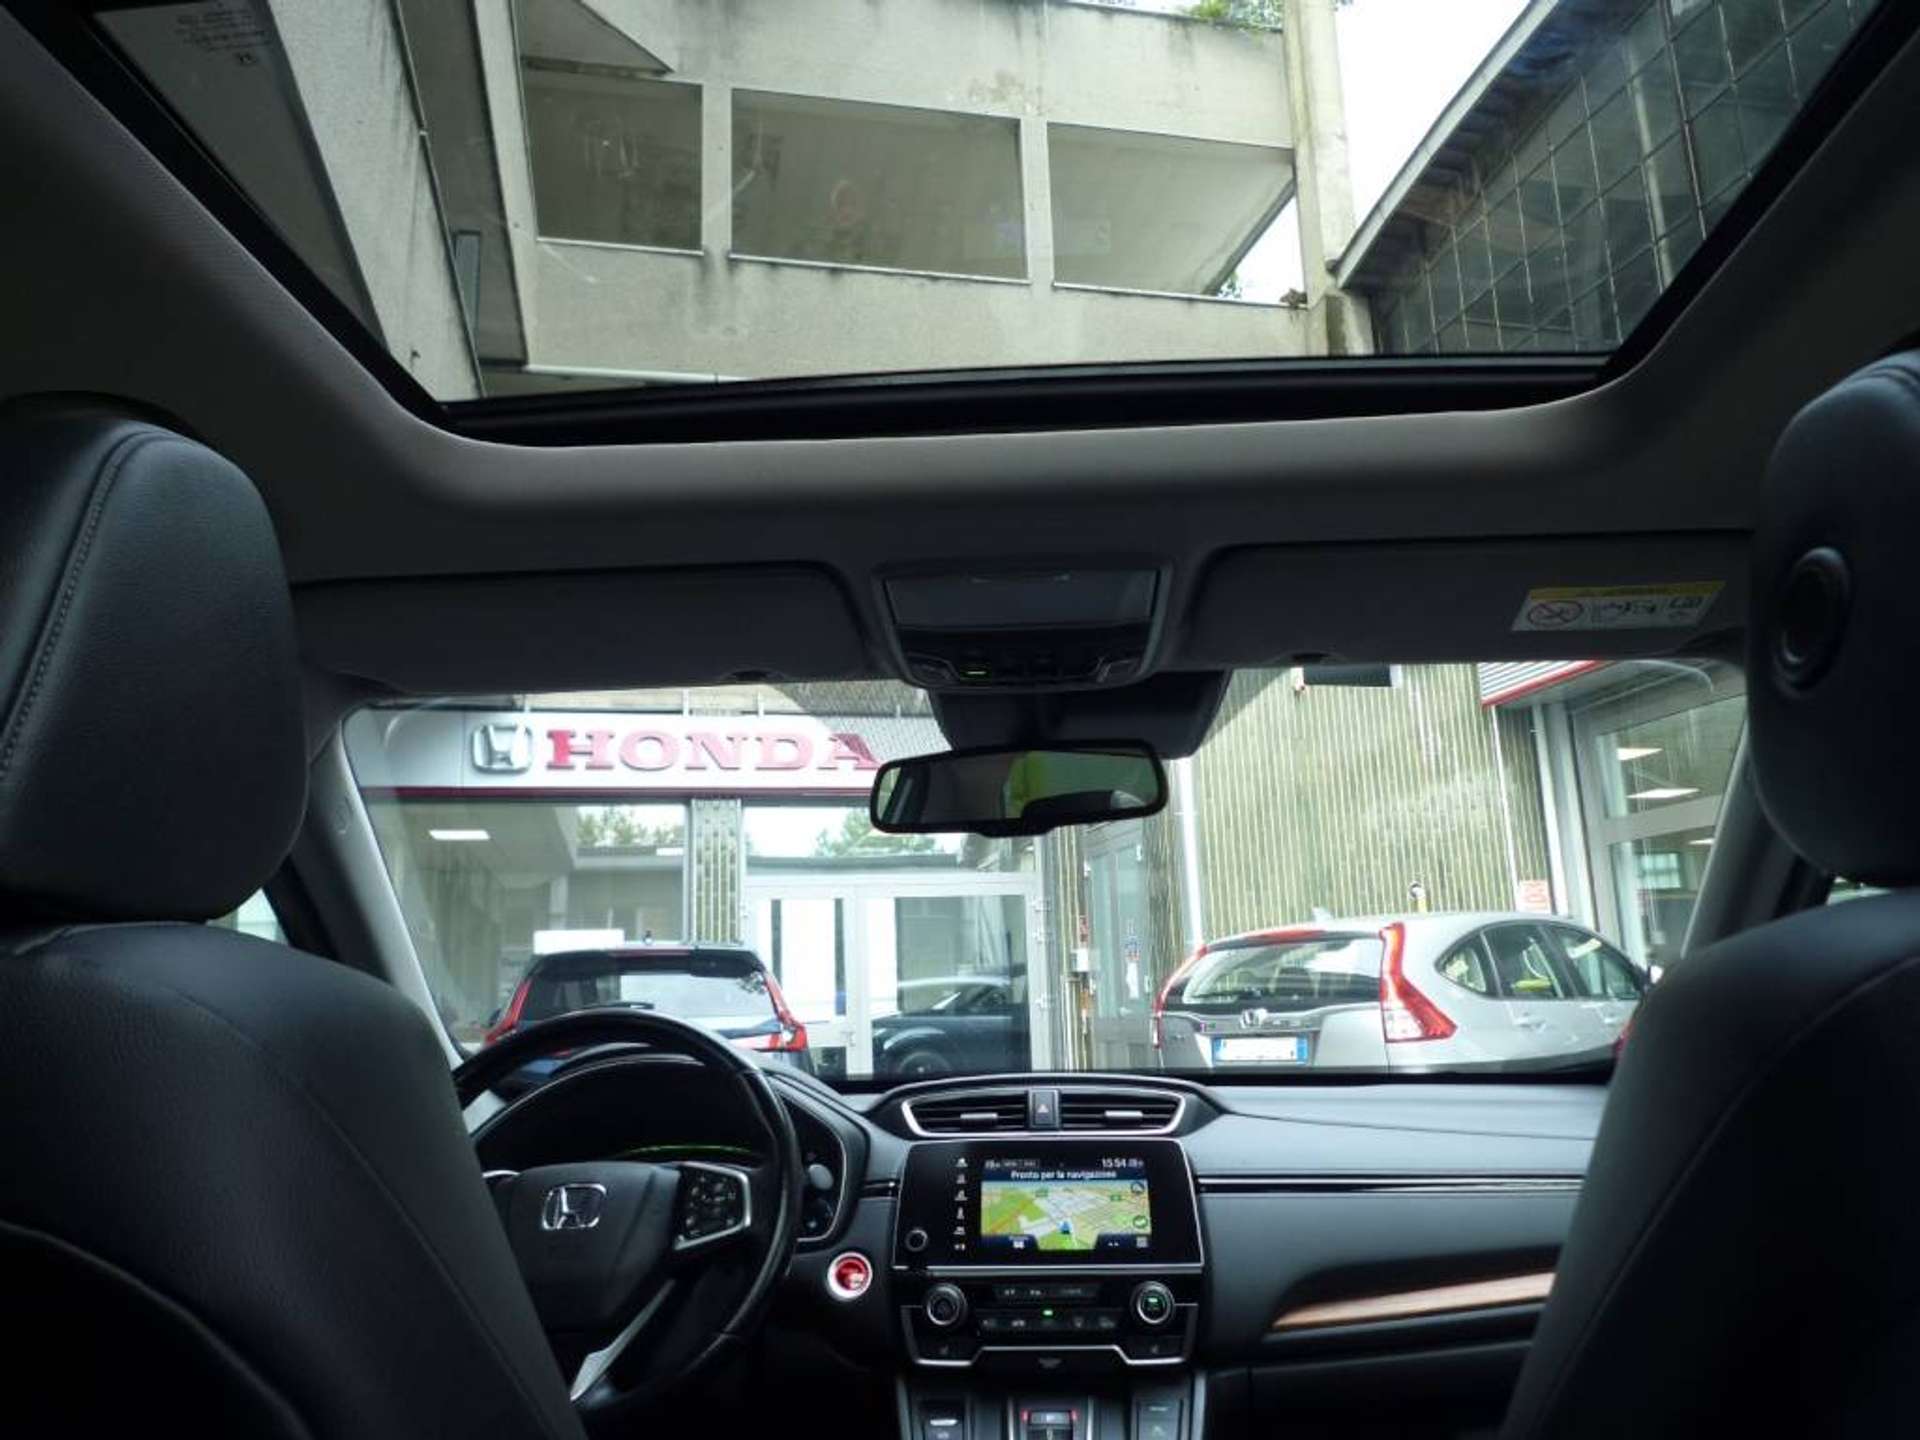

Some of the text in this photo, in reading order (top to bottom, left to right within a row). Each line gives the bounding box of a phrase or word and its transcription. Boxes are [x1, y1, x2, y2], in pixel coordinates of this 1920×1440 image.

[547, 729, 880, 771] HONDA
[1010, 1170, 1039, 1179] Pronto
[1041, 1171, 1055, 1180] per
